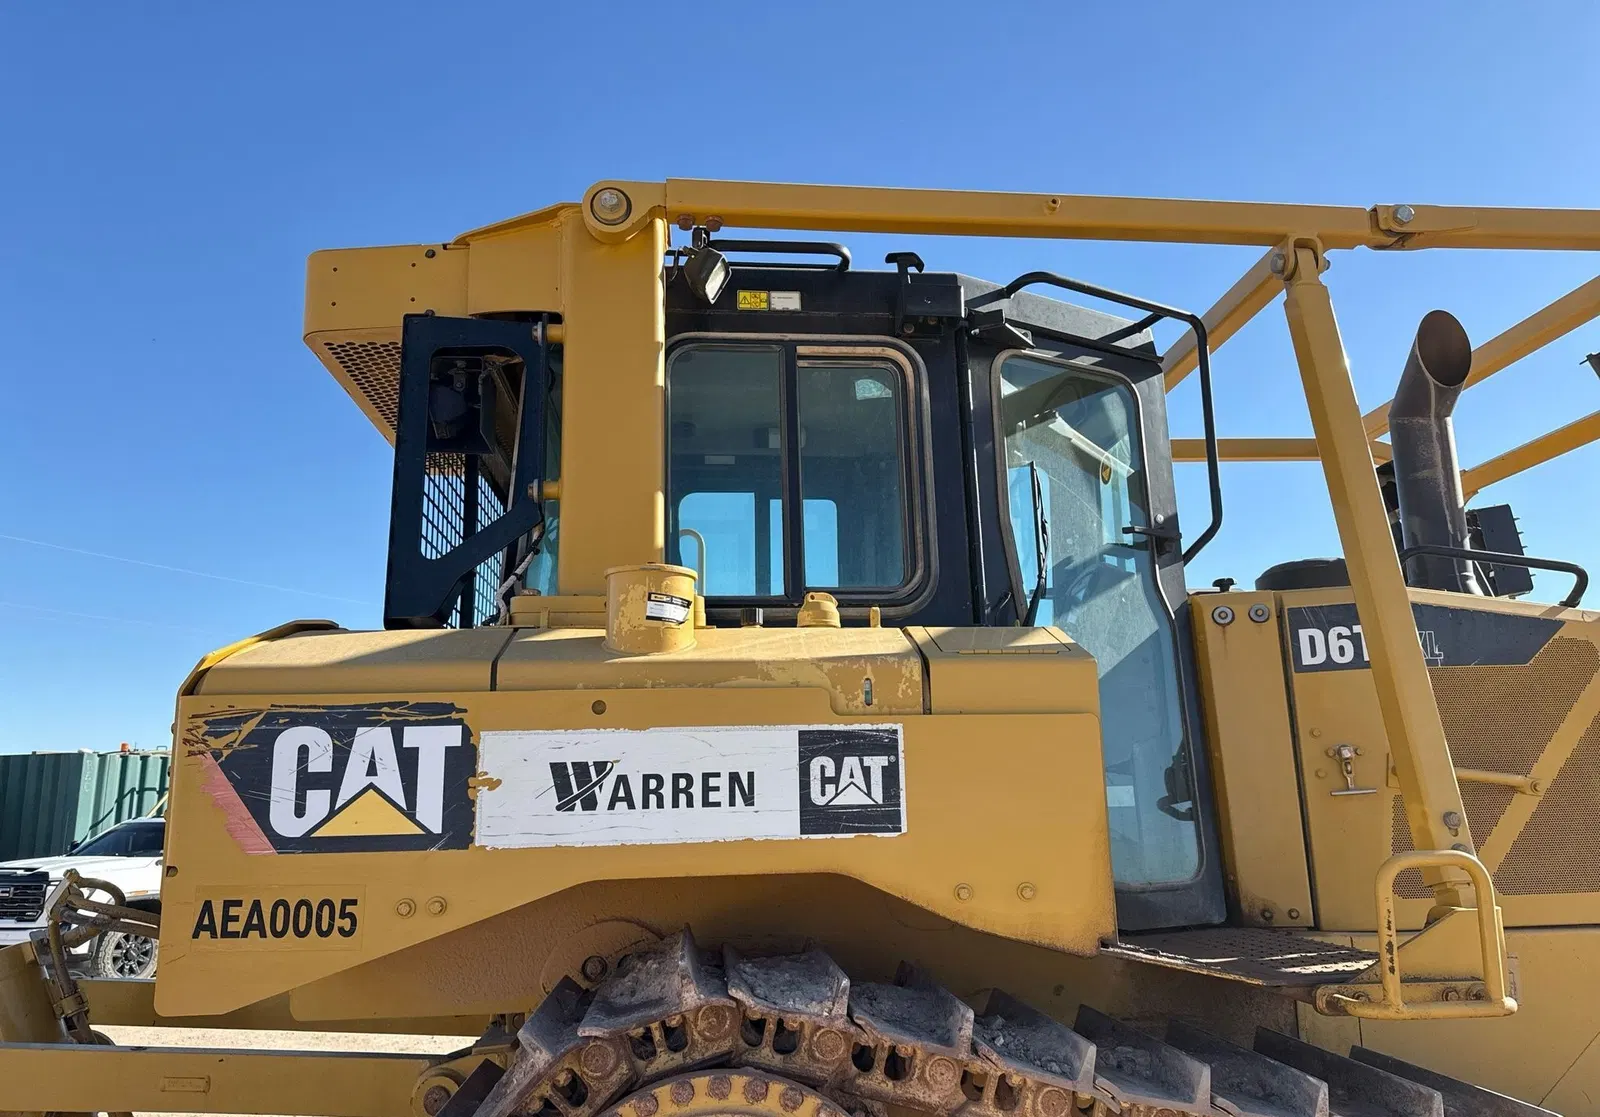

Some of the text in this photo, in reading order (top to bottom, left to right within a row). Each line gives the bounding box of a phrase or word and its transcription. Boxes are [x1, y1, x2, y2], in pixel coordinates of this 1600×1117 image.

[269, 725, 462, 837] CAT
[549, 760, 756, 812] WARREN
[192, 898, 358, 939] AEA0005
